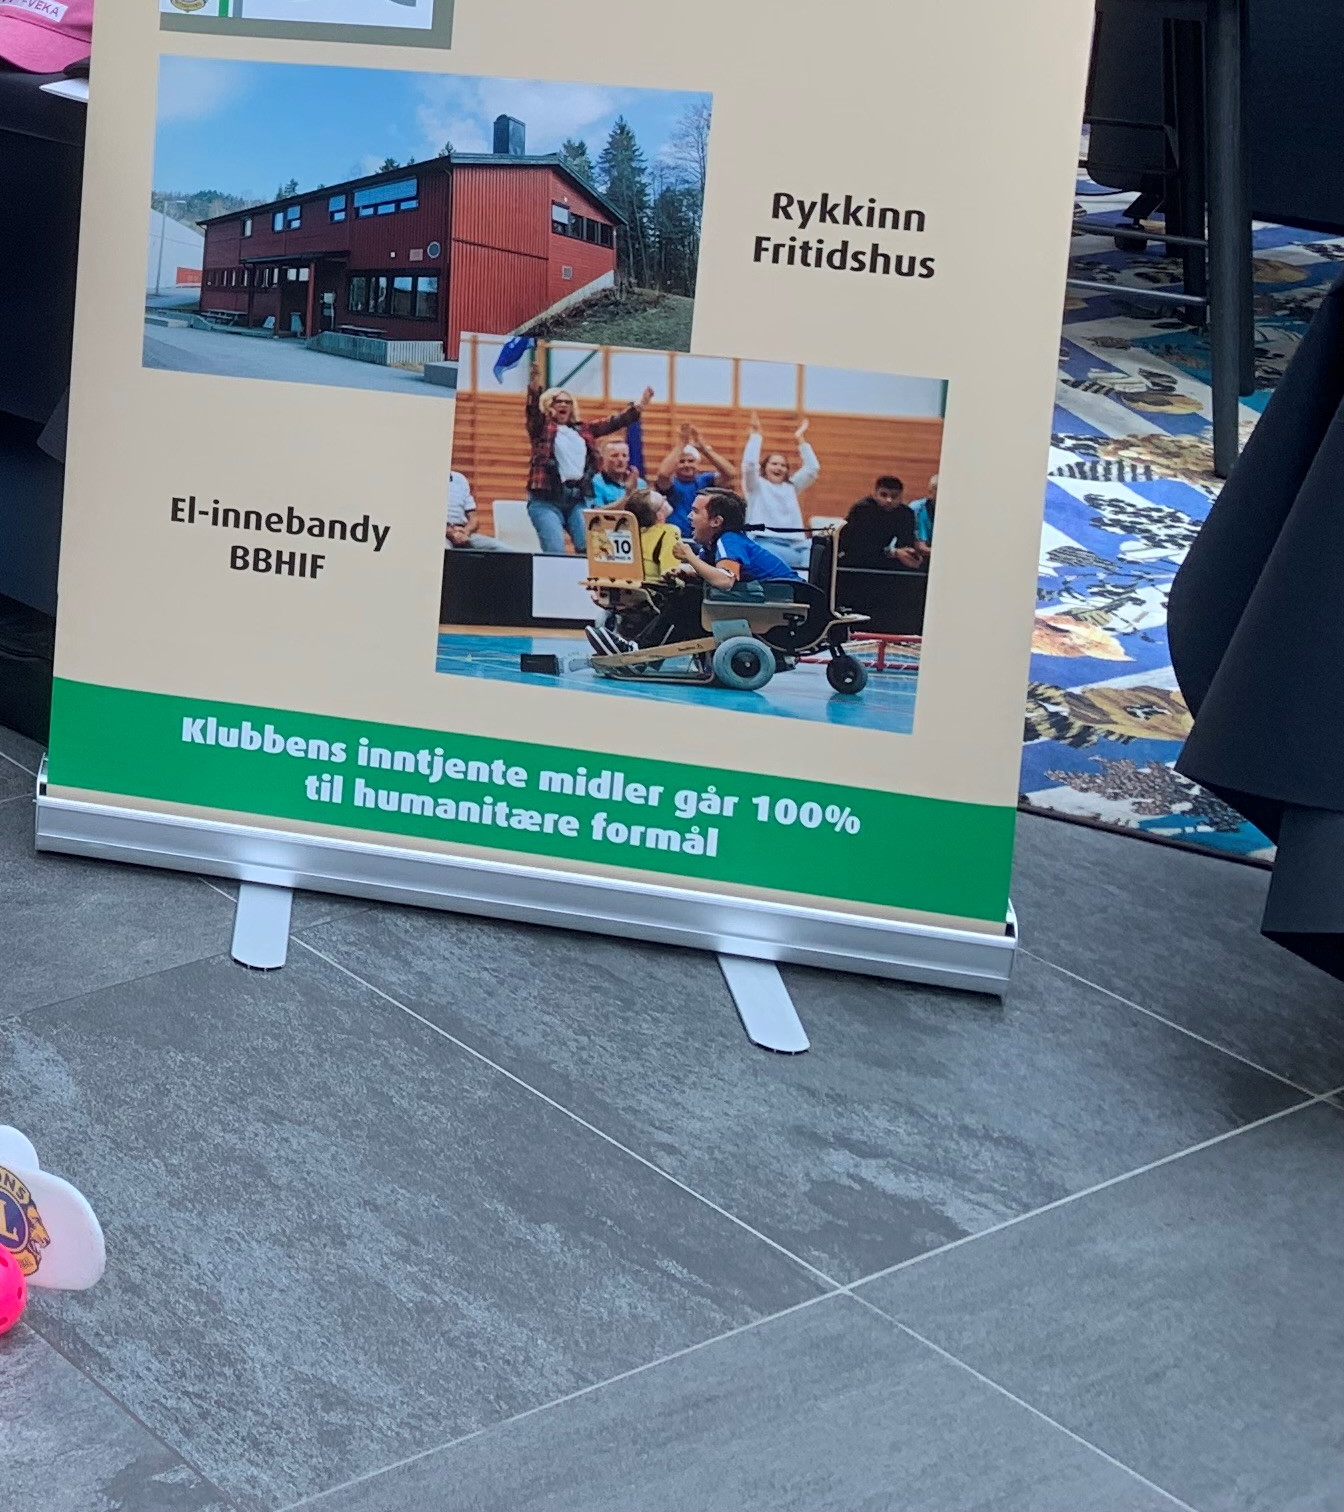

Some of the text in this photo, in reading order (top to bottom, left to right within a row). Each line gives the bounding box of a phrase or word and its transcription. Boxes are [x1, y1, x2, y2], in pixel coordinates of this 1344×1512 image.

[770, 189, 926, 237] Rykkinn
[752, 234, 937, 280] Fritidshus
[170, 495, 391, 553] El-innebandy
[613, 537, 631, 554] 10
[228, 545, 327, 580] BBHIF
[181, 716, 861, 835] Klubbens inntjente midler går 100%
[305, 774, 719, 858] til humanitære formål
